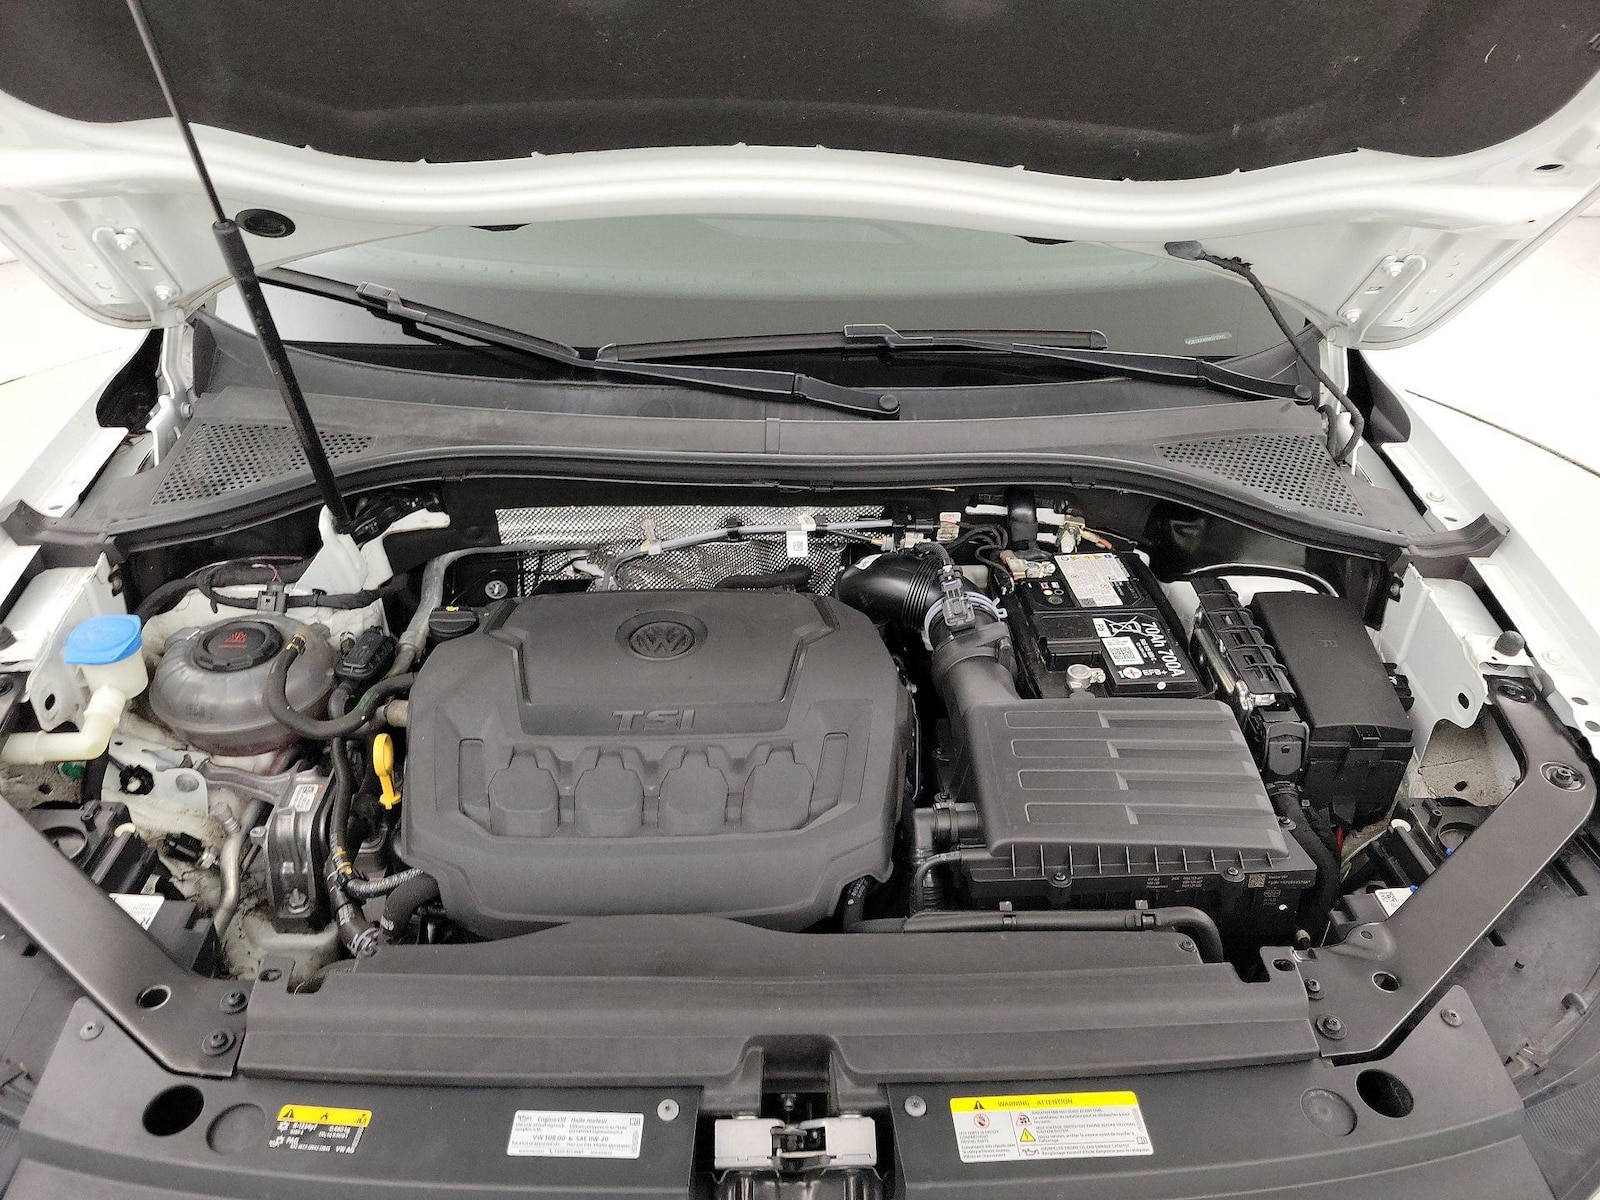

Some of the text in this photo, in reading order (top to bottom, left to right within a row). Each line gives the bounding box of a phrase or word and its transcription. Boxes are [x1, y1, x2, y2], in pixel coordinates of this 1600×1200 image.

[1142, 621, 1165, 648] 70Ah
[1158, 649, 1185, 677] 700A
[611, 709, 695, 731] TSI
[335, 1145, 346, 1153] VW
